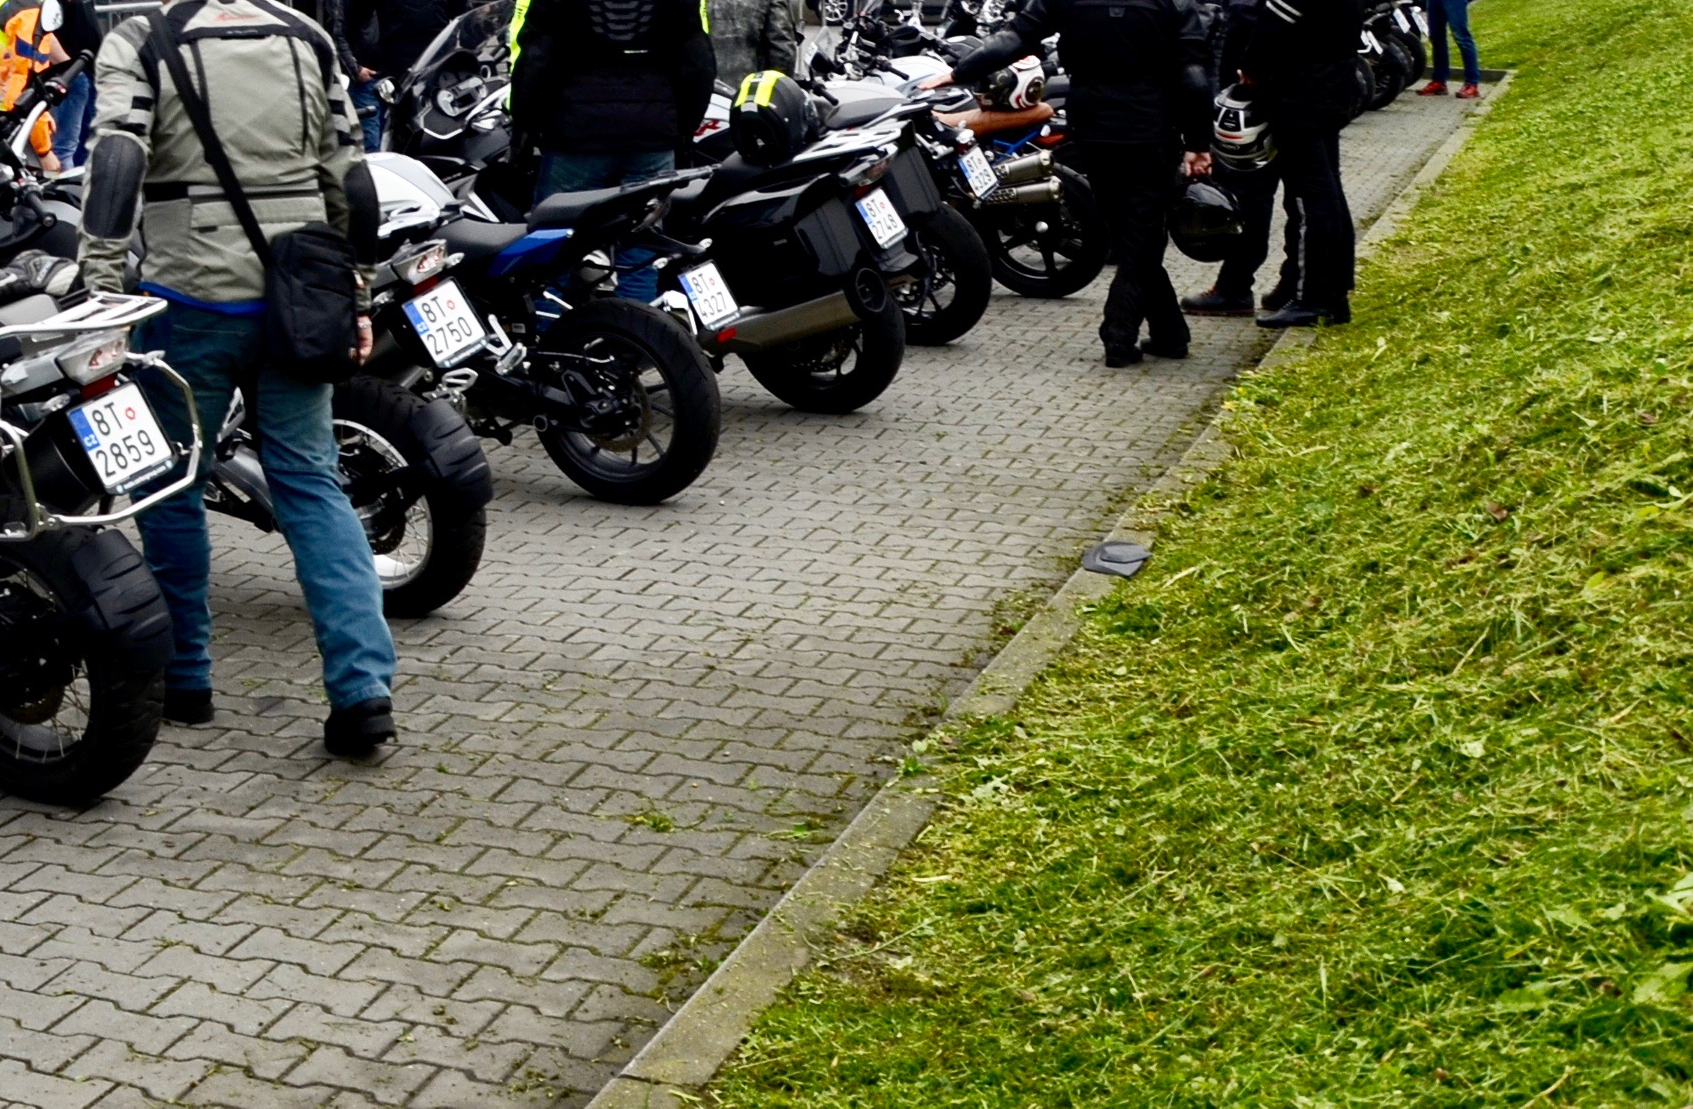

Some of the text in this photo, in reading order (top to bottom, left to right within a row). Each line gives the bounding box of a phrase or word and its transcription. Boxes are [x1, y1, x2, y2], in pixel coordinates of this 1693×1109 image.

[692, 273, 710, 294] 8T
[421, 296, 446, 323] 8T
[426, 316, 473, 356] 2750
[92, 402, 123, 436] 8T
[84, 434, 101, 448] CZ
[96, 429, 155, 478] 2859
